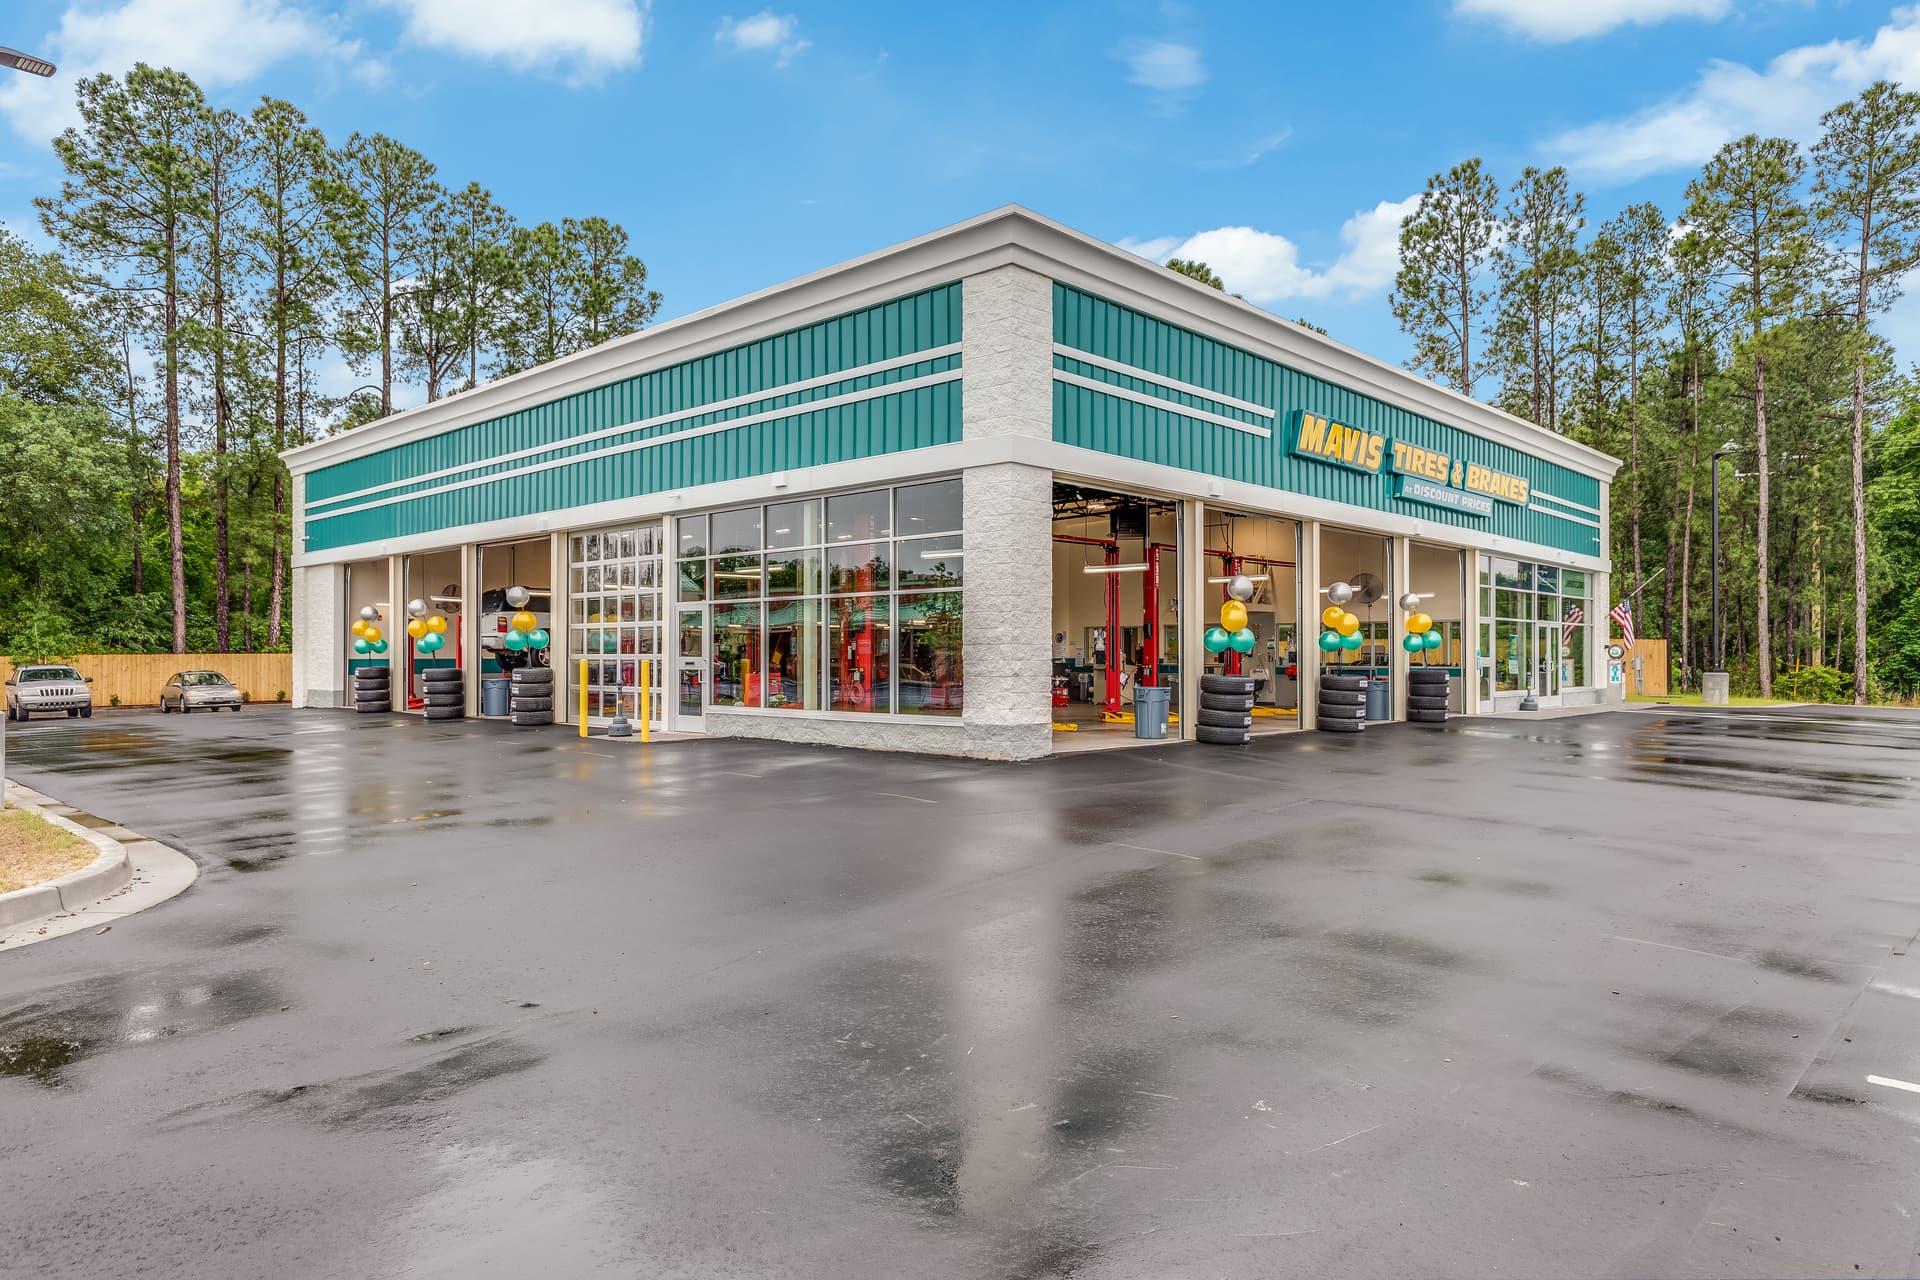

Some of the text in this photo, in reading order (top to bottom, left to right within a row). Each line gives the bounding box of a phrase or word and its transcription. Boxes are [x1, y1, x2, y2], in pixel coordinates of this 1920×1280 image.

[1299, 414, 1528, 503] MAVIS TIRES & BRAKES
[1413, 484, 1460, 505] DISCOUNT
[1461, 496, 1491, 513] PRICES
